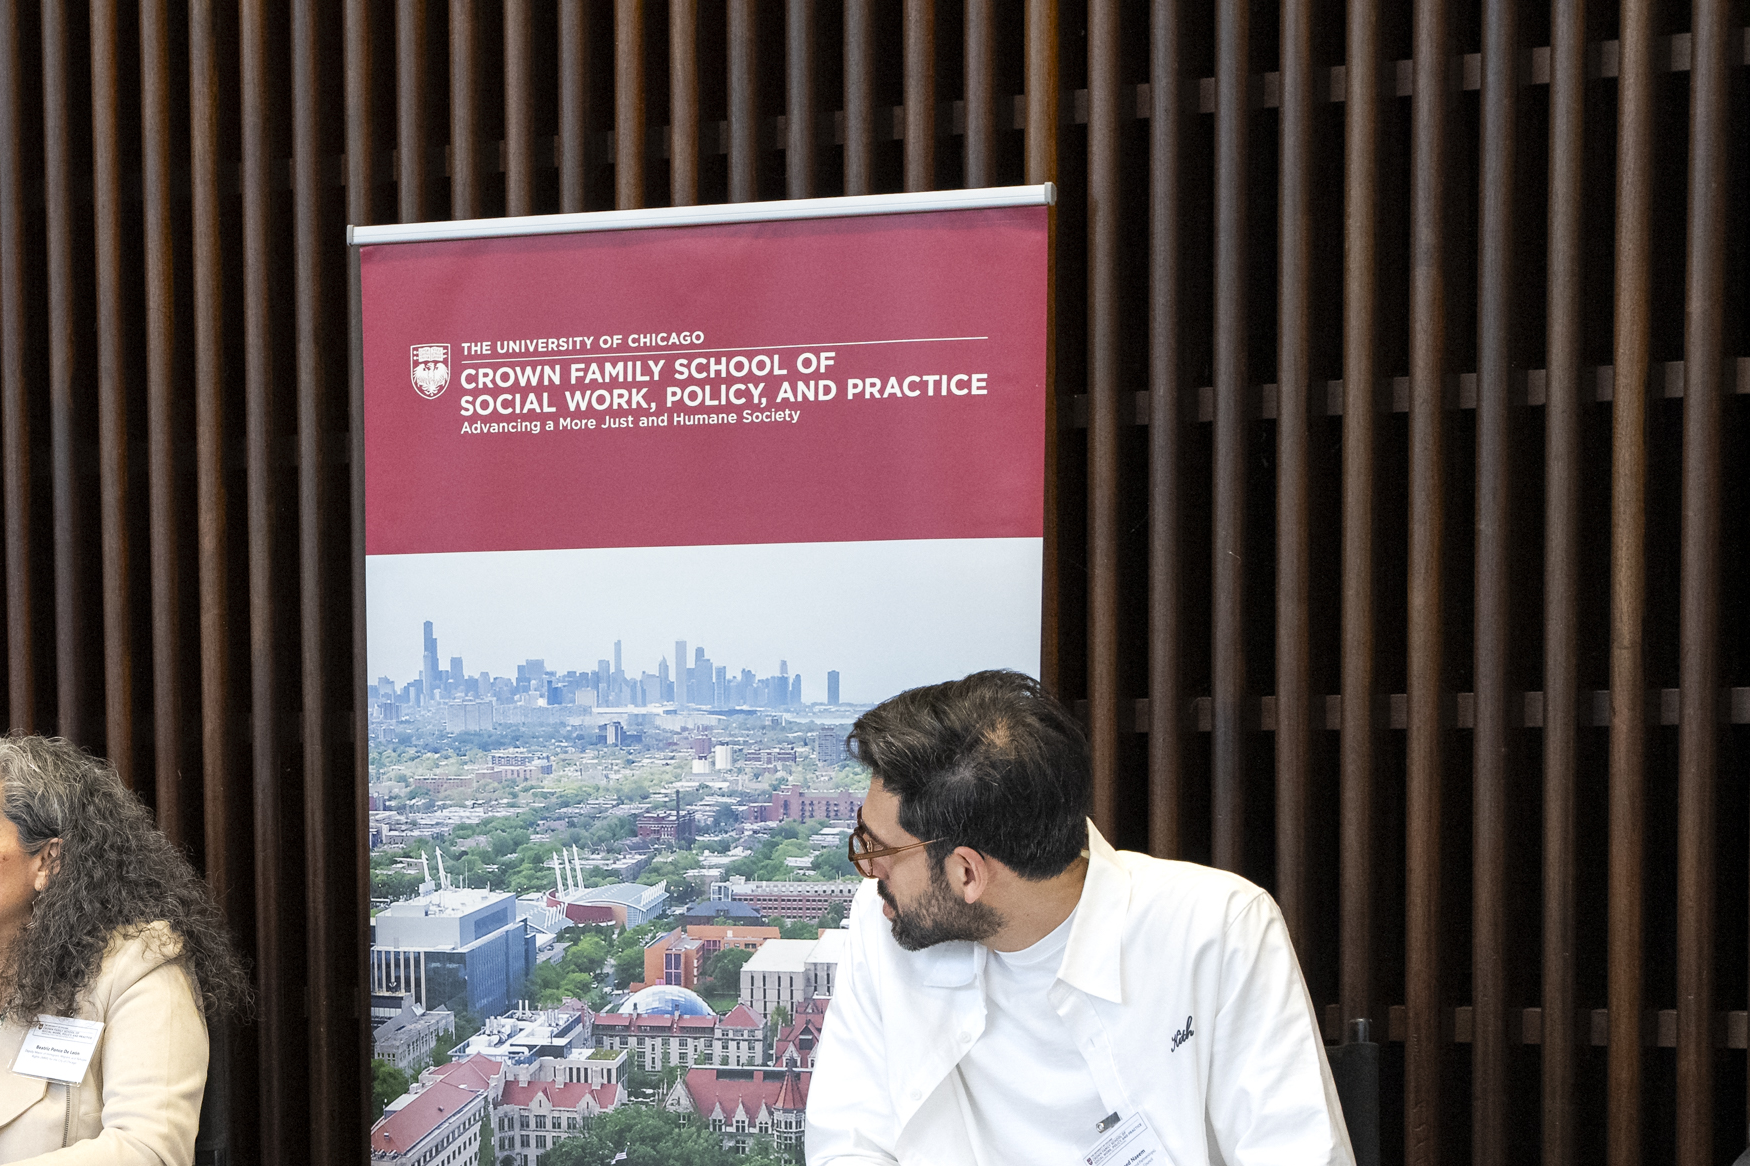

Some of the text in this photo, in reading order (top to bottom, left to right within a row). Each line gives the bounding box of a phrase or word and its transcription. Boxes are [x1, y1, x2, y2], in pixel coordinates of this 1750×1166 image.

[462, 330, 705, 356] THE UNIVERSITY OF CHICAGO
[460, 351, 836, 389] CROWN FAMILY SCHOOL OF
[460, 373, 989, 416] SOCIAL WORK, POLICY, AND PRACTICE
[460, 408, 801, 434] Advancing a More Just and Humane Society
[1170, 1015, 1195, 1053] Kith
[1130, 1149, 1145, 1162] Naeem
